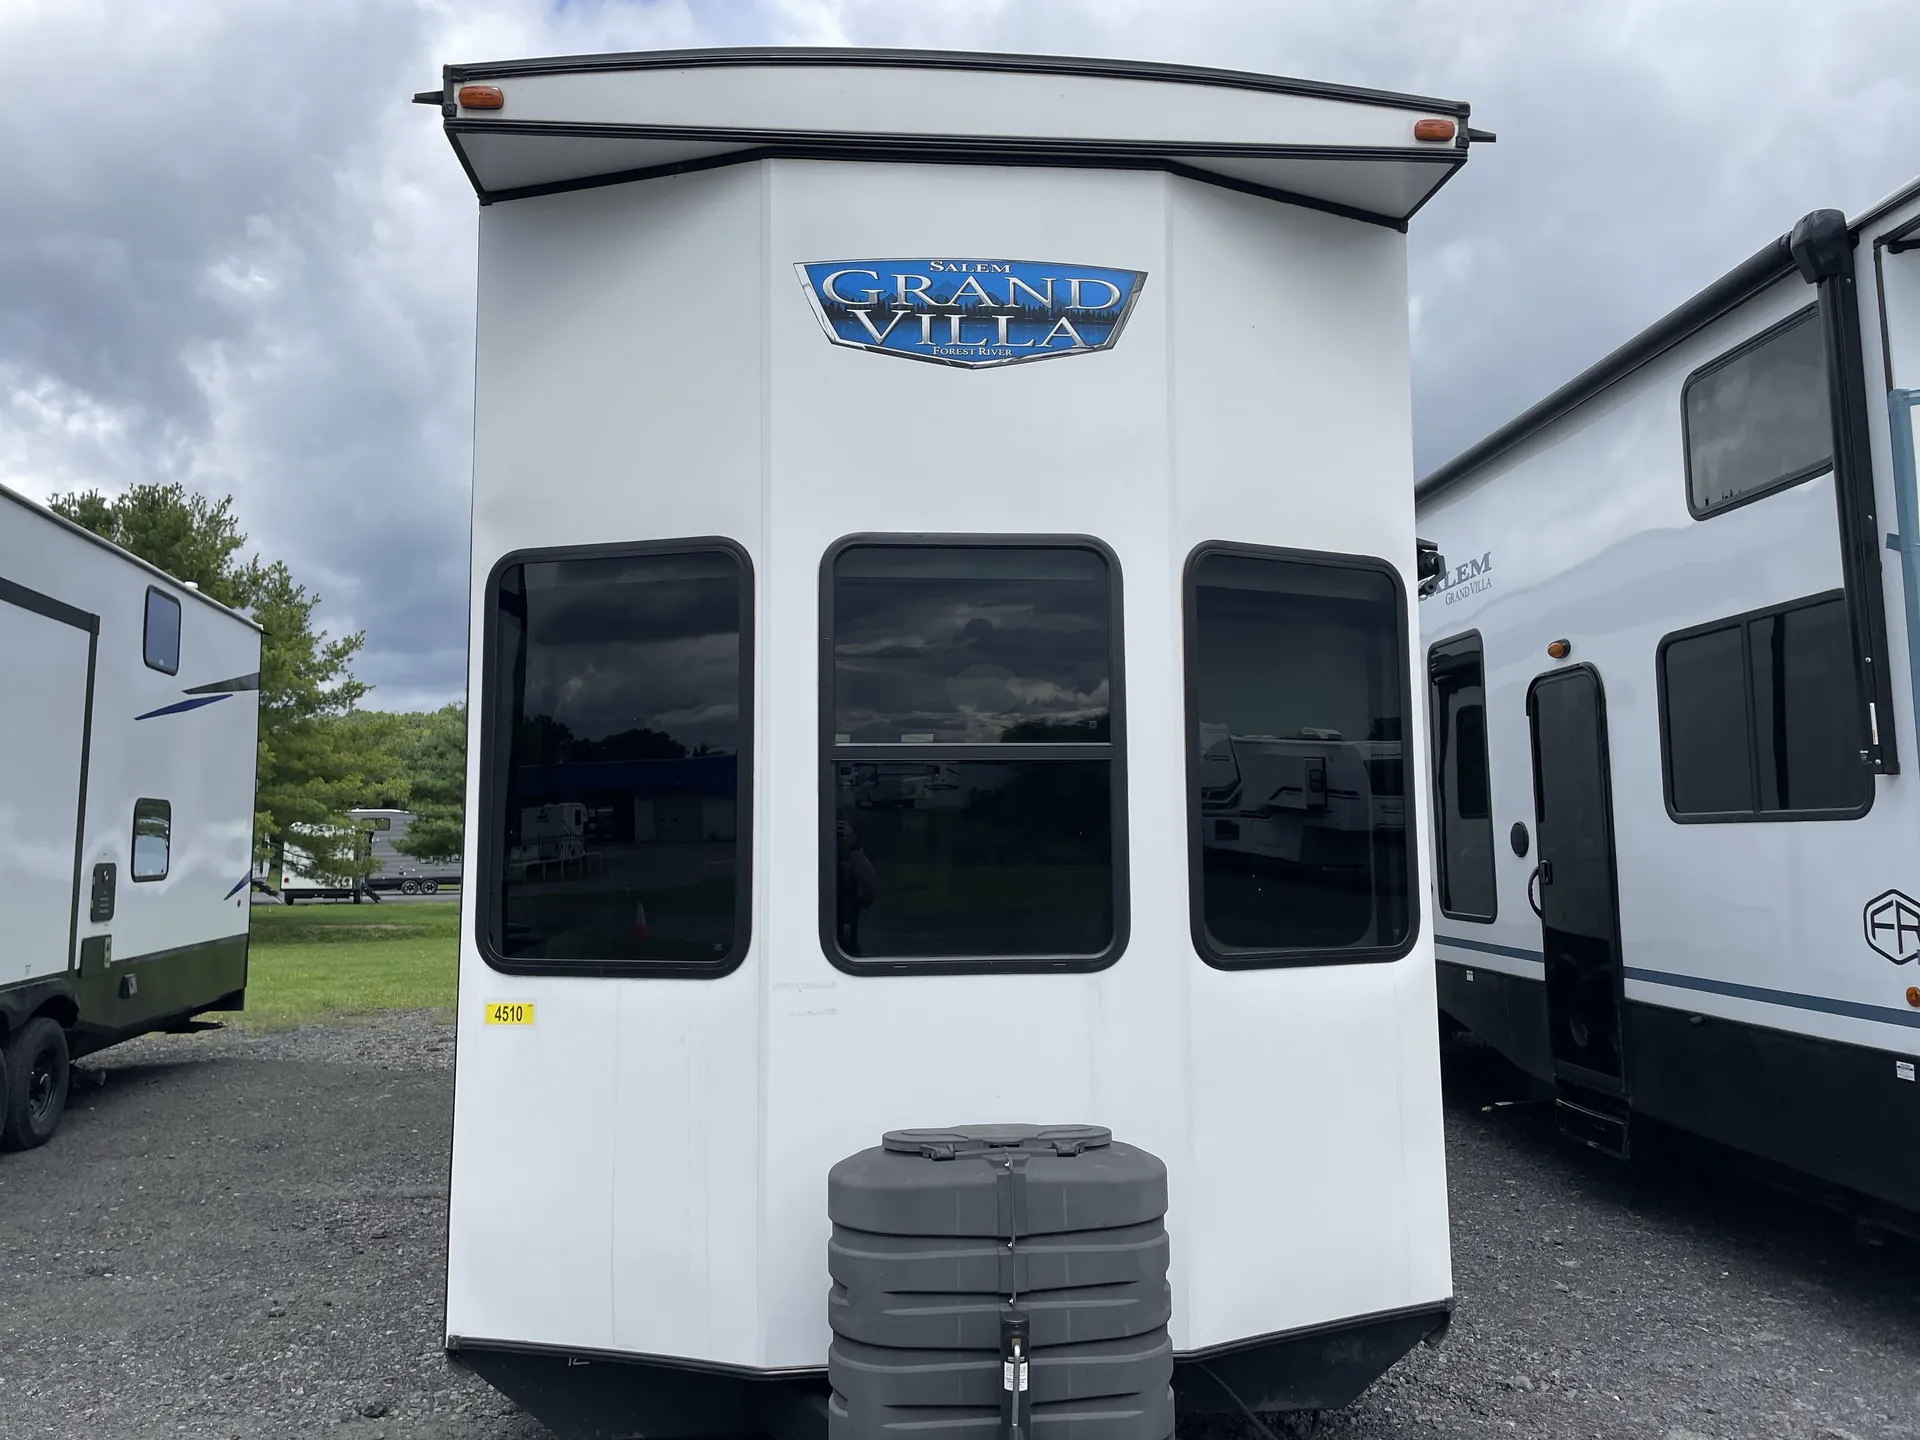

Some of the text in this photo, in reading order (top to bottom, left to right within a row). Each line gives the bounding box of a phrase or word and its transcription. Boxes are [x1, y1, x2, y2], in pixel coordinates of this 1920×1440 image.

[929, 260, 1012, 273] SALEM
[822, 269, 1121, 310] GRAND
[846, 308, 1090, 348] VILLA
[932, 346, 1012, 356] FOREST RIVER
[1445, 577, 1493, 606] GRAND VILLA
[494, 1005, 523, 1022] 4510
